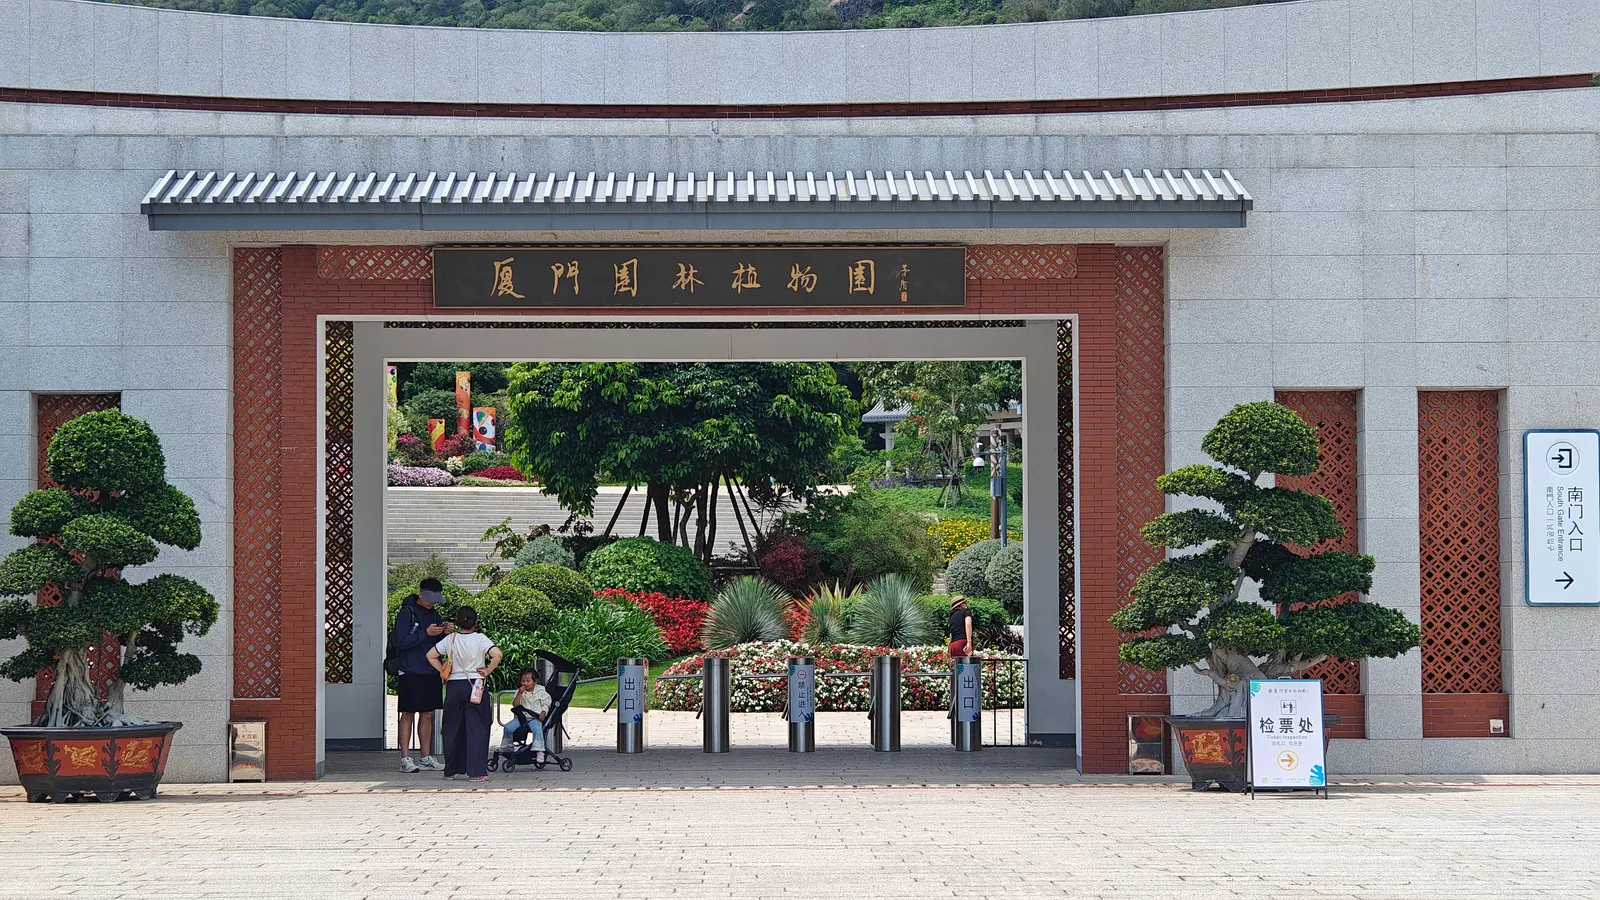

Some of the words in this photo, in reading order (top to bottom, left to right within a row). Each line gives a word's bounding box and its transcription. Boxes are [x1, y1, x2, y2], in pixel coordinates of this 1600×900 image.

[1567, 486, 1584, 552] 南门入口
[624, 677, 635, 711] 出口
[797, 681, 806, 718] 禁止进入
[963, 675, 974, 709] 出口
[1259, 717, 1314, 734] 检票处
